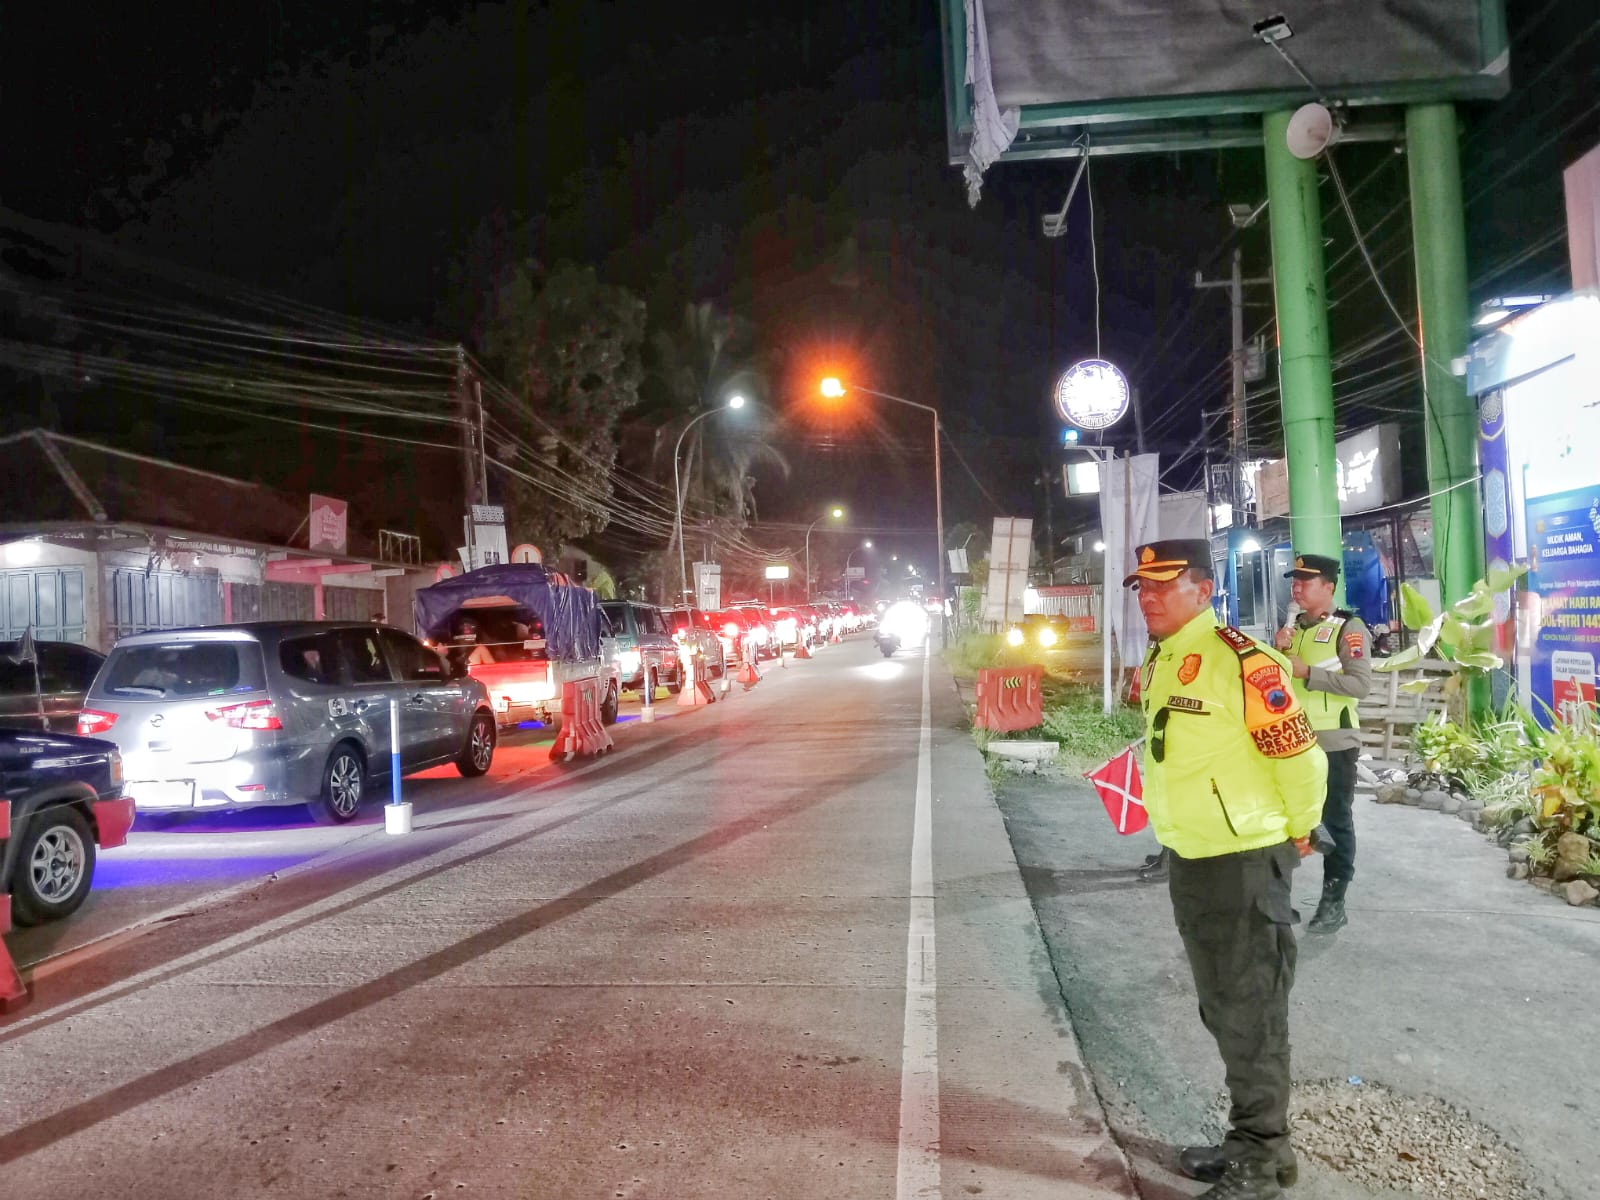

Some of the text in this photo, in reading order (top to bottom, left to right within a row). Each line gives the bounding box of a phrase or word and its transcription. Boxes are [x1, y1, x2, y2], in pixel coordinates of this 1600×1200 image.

[1568, 544, 1593, 555] BAHAGIA
[1570, 595, 1588, 608] HARI
[1169, 696, 1199, 708] POLRI
[1276, 736, 1309, 753] KETUPAT
